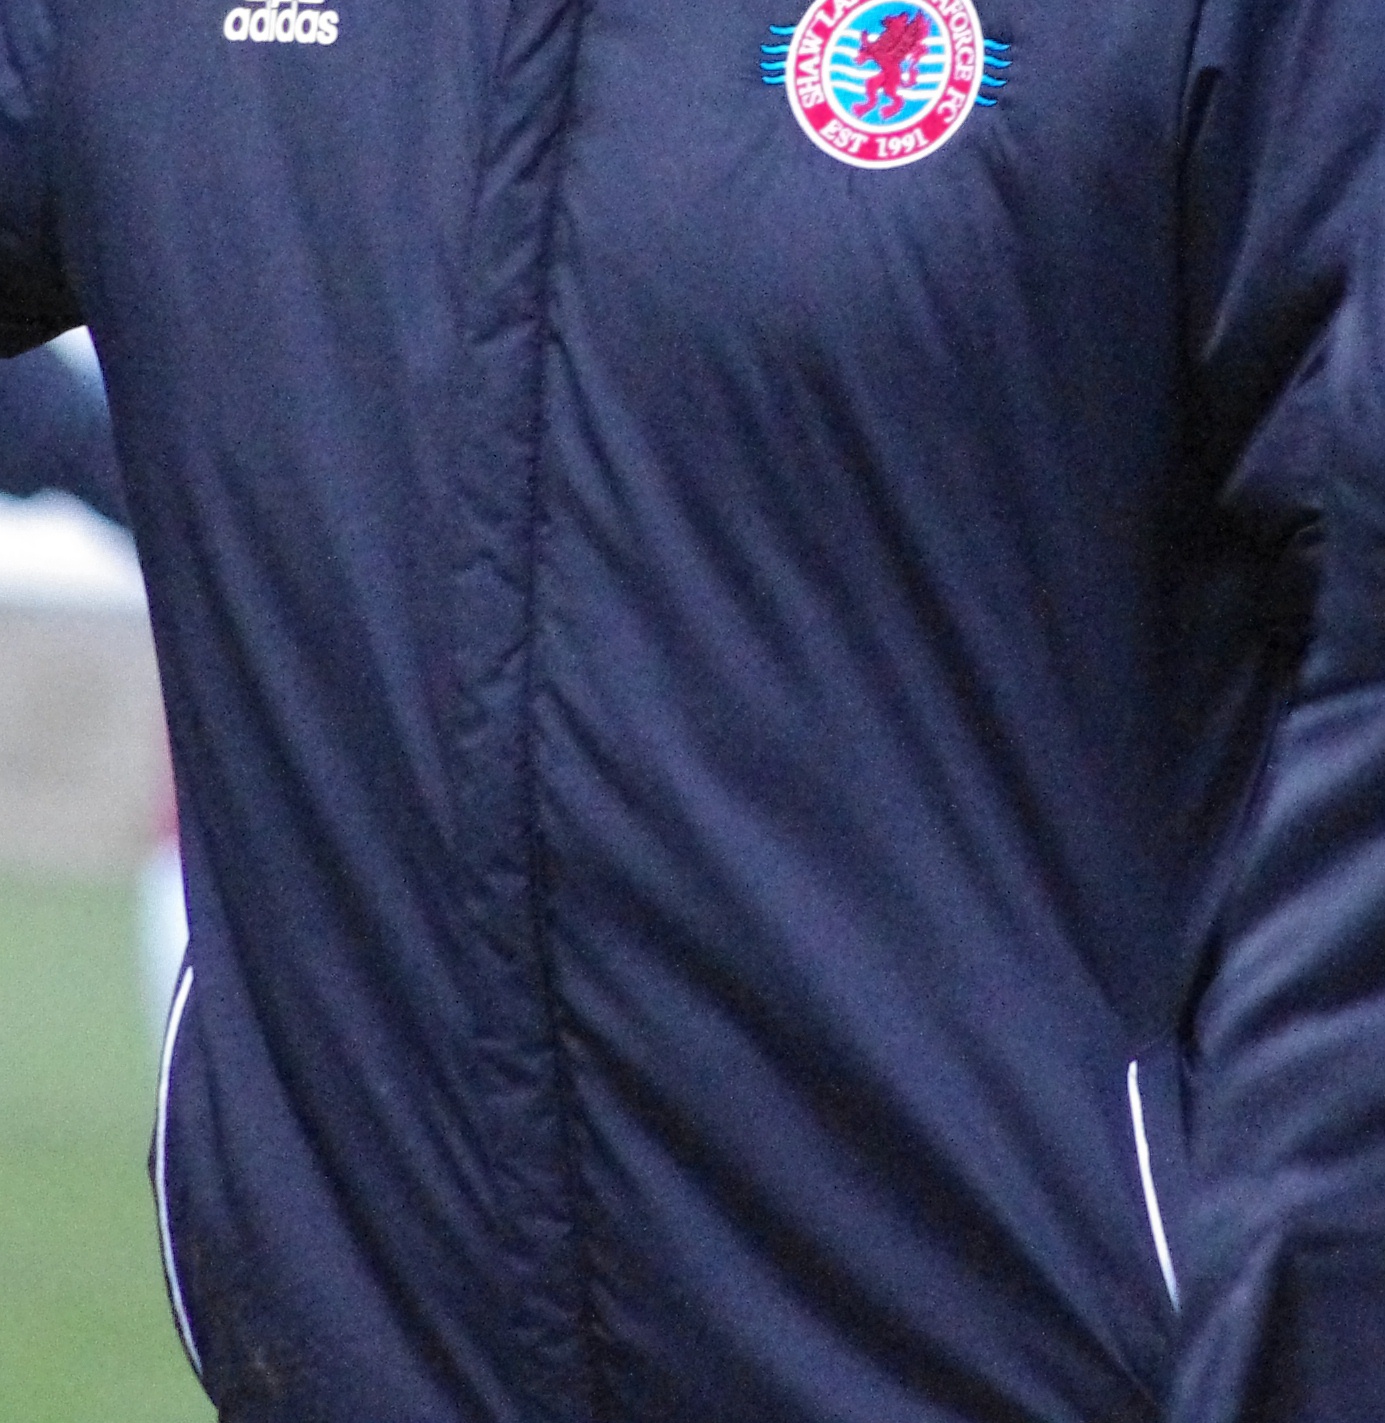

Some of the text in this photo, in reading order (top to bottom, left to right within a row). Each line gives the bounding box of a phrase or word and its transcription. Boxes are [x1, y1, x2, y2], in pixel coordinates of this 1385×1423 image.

[794, 19, 824, 108] SHAW
[937, 87, 964, 123] FC
[819, 119, 929, 157] EST 1991
